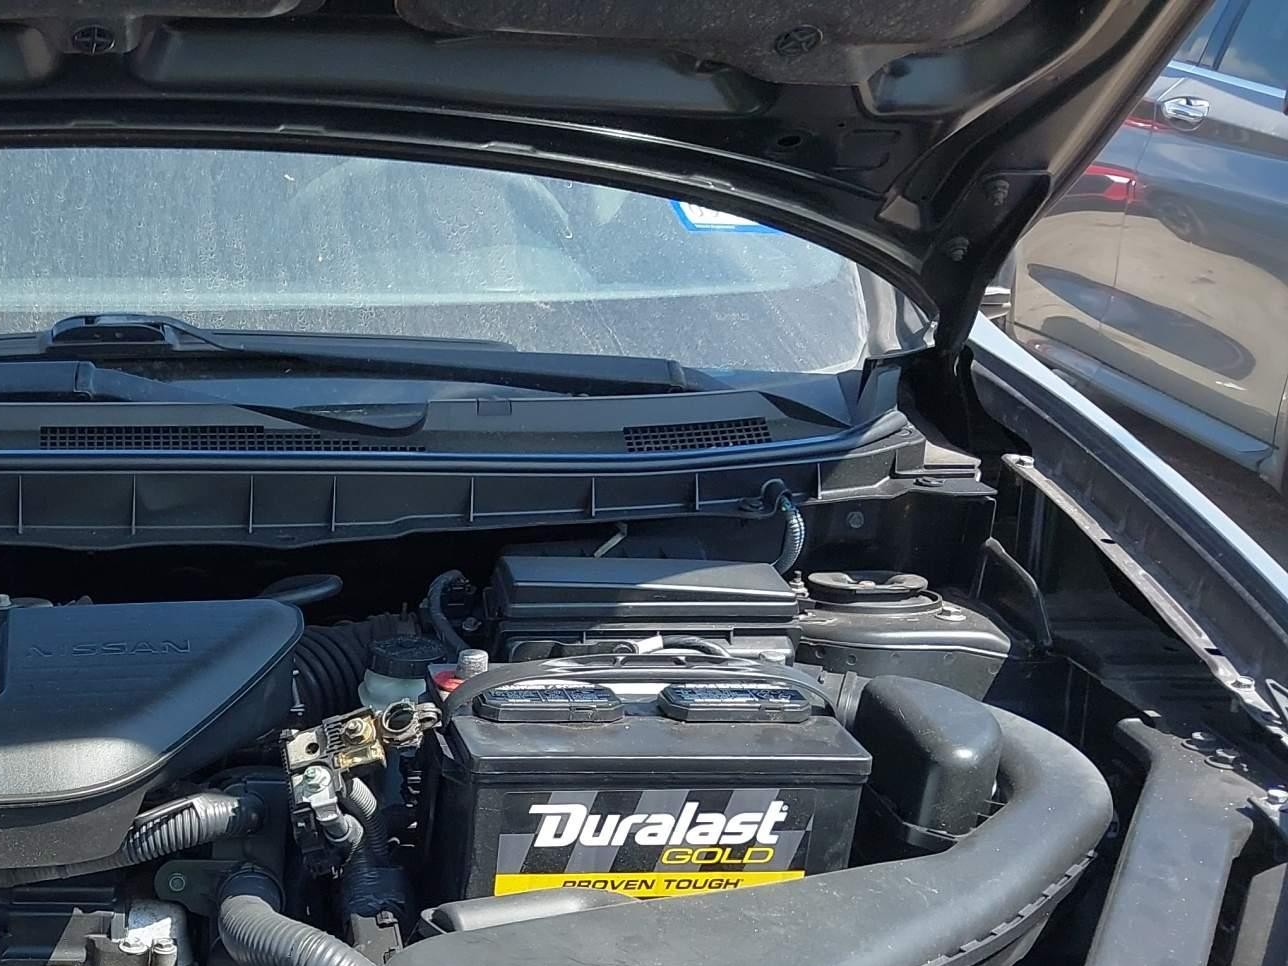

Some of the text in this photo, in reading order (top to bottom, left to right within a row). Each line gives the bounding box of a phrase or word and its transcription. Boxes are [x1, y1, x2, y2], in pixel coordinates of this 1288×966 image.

[26, 639, 191, 658] NISSAN
[528, 800, 789, 848] Duralast
[661, 847, 776, 865] GOLD
[664, 878, 741, 890] TOUGH
